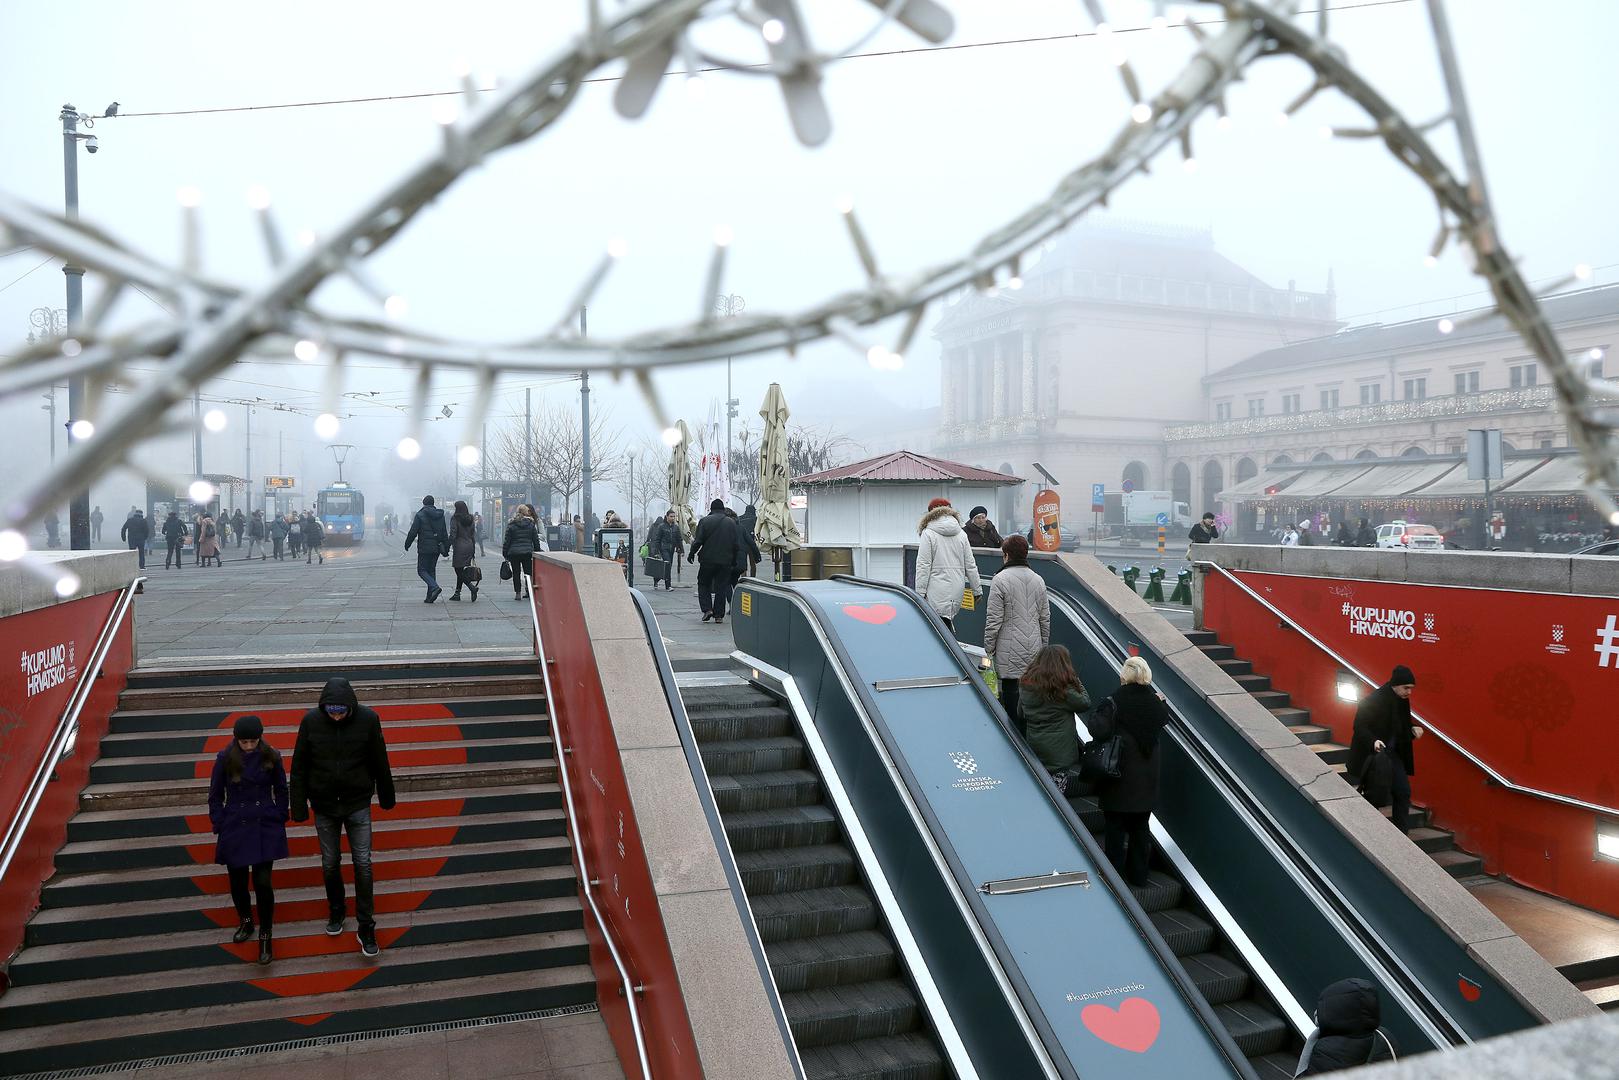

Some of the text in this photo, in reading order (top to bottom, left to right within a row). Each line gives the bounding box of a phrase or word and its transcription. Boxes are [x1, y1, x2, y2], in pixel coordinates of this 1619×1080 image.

[1342, 602, 1415, 626] #KUPUJMO
[1350, 620, 1415, 641] HRVATSKO
[21, 644, 65, 676] #KUPUJMO
[28, 664, 65, 698] HRVATSKO
[1066, 982, 1145, 1002] #kupujmohrvatsko
